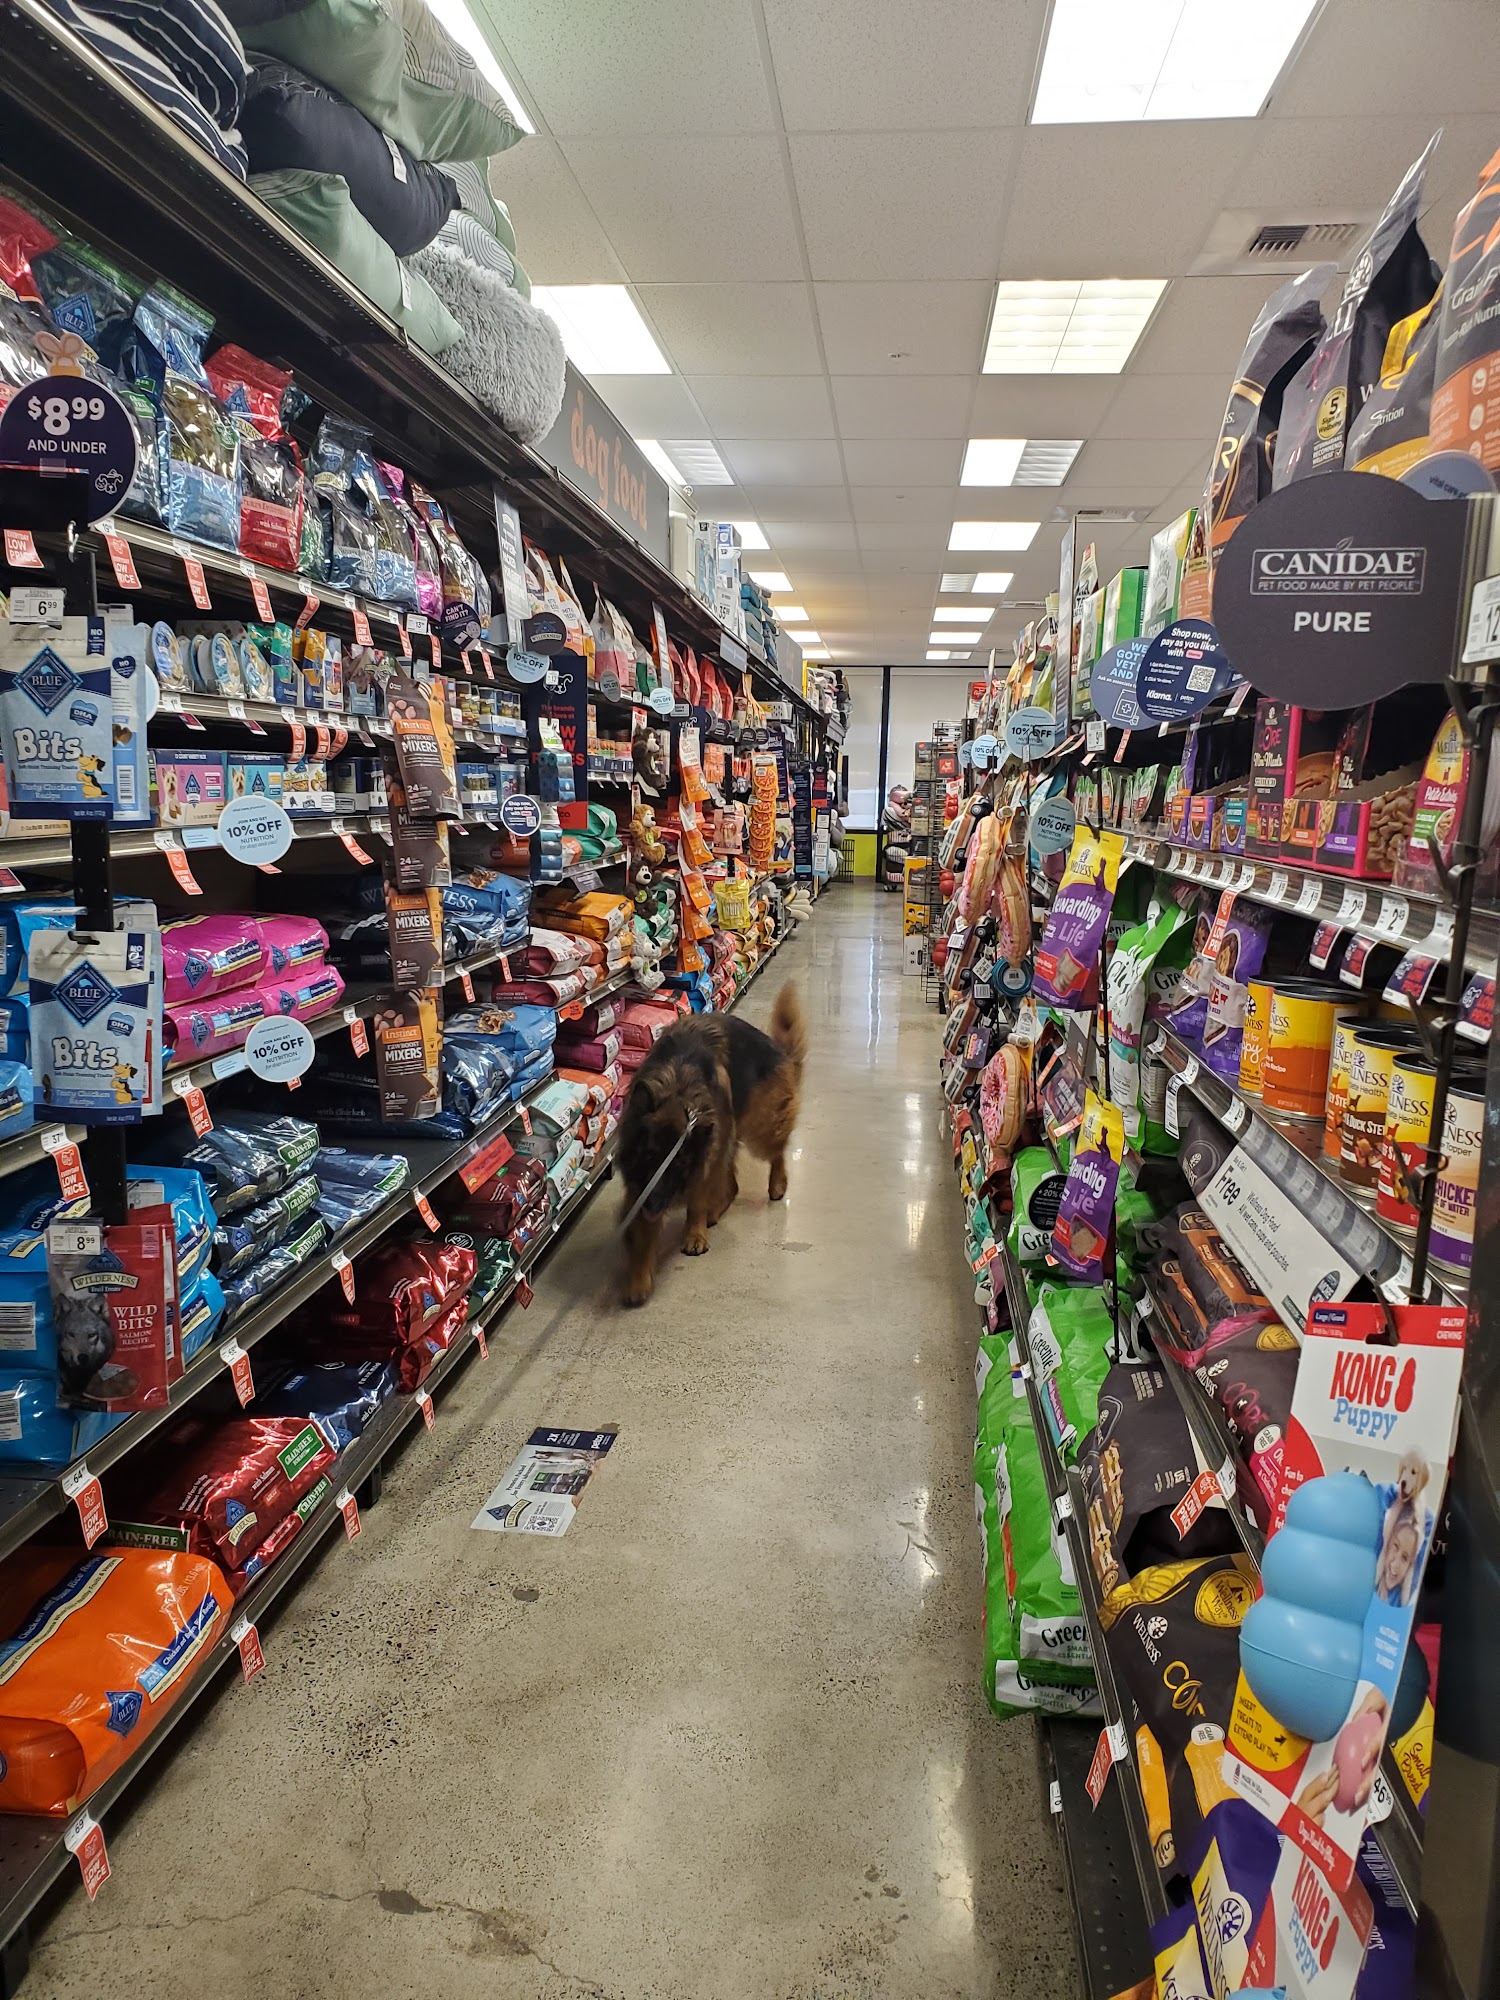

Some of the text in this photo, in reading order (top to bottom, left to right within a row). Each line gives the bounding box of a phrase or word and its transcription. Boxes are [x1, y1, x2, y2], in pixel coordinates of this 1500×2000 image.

[1329, 396, 1339, 415] 5
[1322, 412, 1335, 426] Signs
[27, 438, 107, 455] AND UNDER
[571, 389, 648, 531] dog food
[1429, 474, 1459, 496] vital care
[8, 538, 27, 551] LOW
[1260, 551, 1416, 576] CANIDAE
[1258, 580, 1415, 591] PET FOOD MADE BY PET PEOPLE
[445, 604, 464, 615] CAN'T
[445, 610, 469, 622] FIND IT?
[1293, 611, 1372, 632] PURE
[90, 628, 103, 636] NO
[1171, 628, 1212, 642] Shop now,
[1131, 642, 1148, 652] WE
[1160, 638, 1175, 648] pay
[1176, 640, 1184, 648] as
[1184, 642, 1198, 651] you
[1117, 650, 1139, 660] GOT
[1167, 648, 1185, 658] with
[513, 653, 545, 669] 10% OFF
[1116, 660, 1135, 669] VET
[32, 675, 62, 686] BLUE
[1109, 667, 1133, 679] AND
[73, 709, 92, 719] DHA
[1011, 726, 1030, 737] 10%
[14, 729, 82, 761] Bits
[402, 740, 438, 753] MIXERS
[407, 784, 419, 792] 24
[226, 820, 282, 838] 10% OFF
[1037, 816, 1071, 833] 10% OFF
[240, 834, 275, 844] NUTRITION
[395, 915, 430, 929] MIXERS
[1058, 921, 1084, 946] Life
[69, 987, 101, 998] BLUE
[110, 1020, 130, 1031] DHA
[385, 1029, 418, 1039] Instinct
[53, 1037, 118, 1070] Bits
[253, 1037, 304, 1059] 10% OFF
[385, 1047, 422, 1062] MIXERS
[266, 1051, 298, 1063] NUTRITION
[1447, 1142, 1472, 1157] Topper
[62, 1175, 76, 1187] LOW
[1215, 1165, 1241, 1206] Free
[63, 1183, 84, 1197] PRICE
[1247, 1190, 1281, 1233] Wellness Dog Food
[1447, 1199, 1470, 1217] WATER
[74, 1274, 137, 1287] WILDERNESS
[112, 1304, 158, 1318] WILD
[118, 1317, 153, 1331] BITS
[1440, 1318, 1464, 1328] HEALTHY
[119, 1330, 152, 1338] SALMON
[122, 1336, 150, 1345] RECIPE
[1436, 1331, 1463, 1340] CHEWING
[1194, 1365, 1218, 1399] WELLNESS
[1329, 1350, 1397, 1408] KONG
[1333, 1398, 1398, 1440] Puppy
[546, 1432, 561, 1442] 2X
[591, 1434, 604, 1449] petco
[1258, 1436, 1268, 1449] FREE
[1263, 1429, 1275, 1445] GRAIN
[300, 1480, 327, 1512] GRAIN-FREE
[84, 1515, 99, 1532] LOW
[86, 1519, 105, 1542] PRICE
[89, 1576, 101, 1590] Fruits
[1212, 1594, 1228, 1619] Way
[1215, 1578, 1240, 1622] Wellness
[17, 1613, 42, 1640] Chicken
[1132, 1612, 1162, 1665] WELLNESS
[163, 1647, 181, 1666] Chicken
[118, 1699, 136, 1722] BLUE
[1239, 1696, 1257, 1713] INSERT
[1236, 1709, 1263, 1733] TREATS TO
[1198, 1729, 1207, 1741] FREE
[1203, 1726, 1215, 1741] GRAIN
[1233, 1725, 1279, 1762] EXTEND PLAY TIME
[1409, 1742, 1430, 1779] Small
[1402, 1752, 1421, 1794] Breed
[85, 1859, 100, 1884] LOW
[1291, 1854, 1329, 1950] KONG
[1289, 1904, 1319, 1985] Puppy
